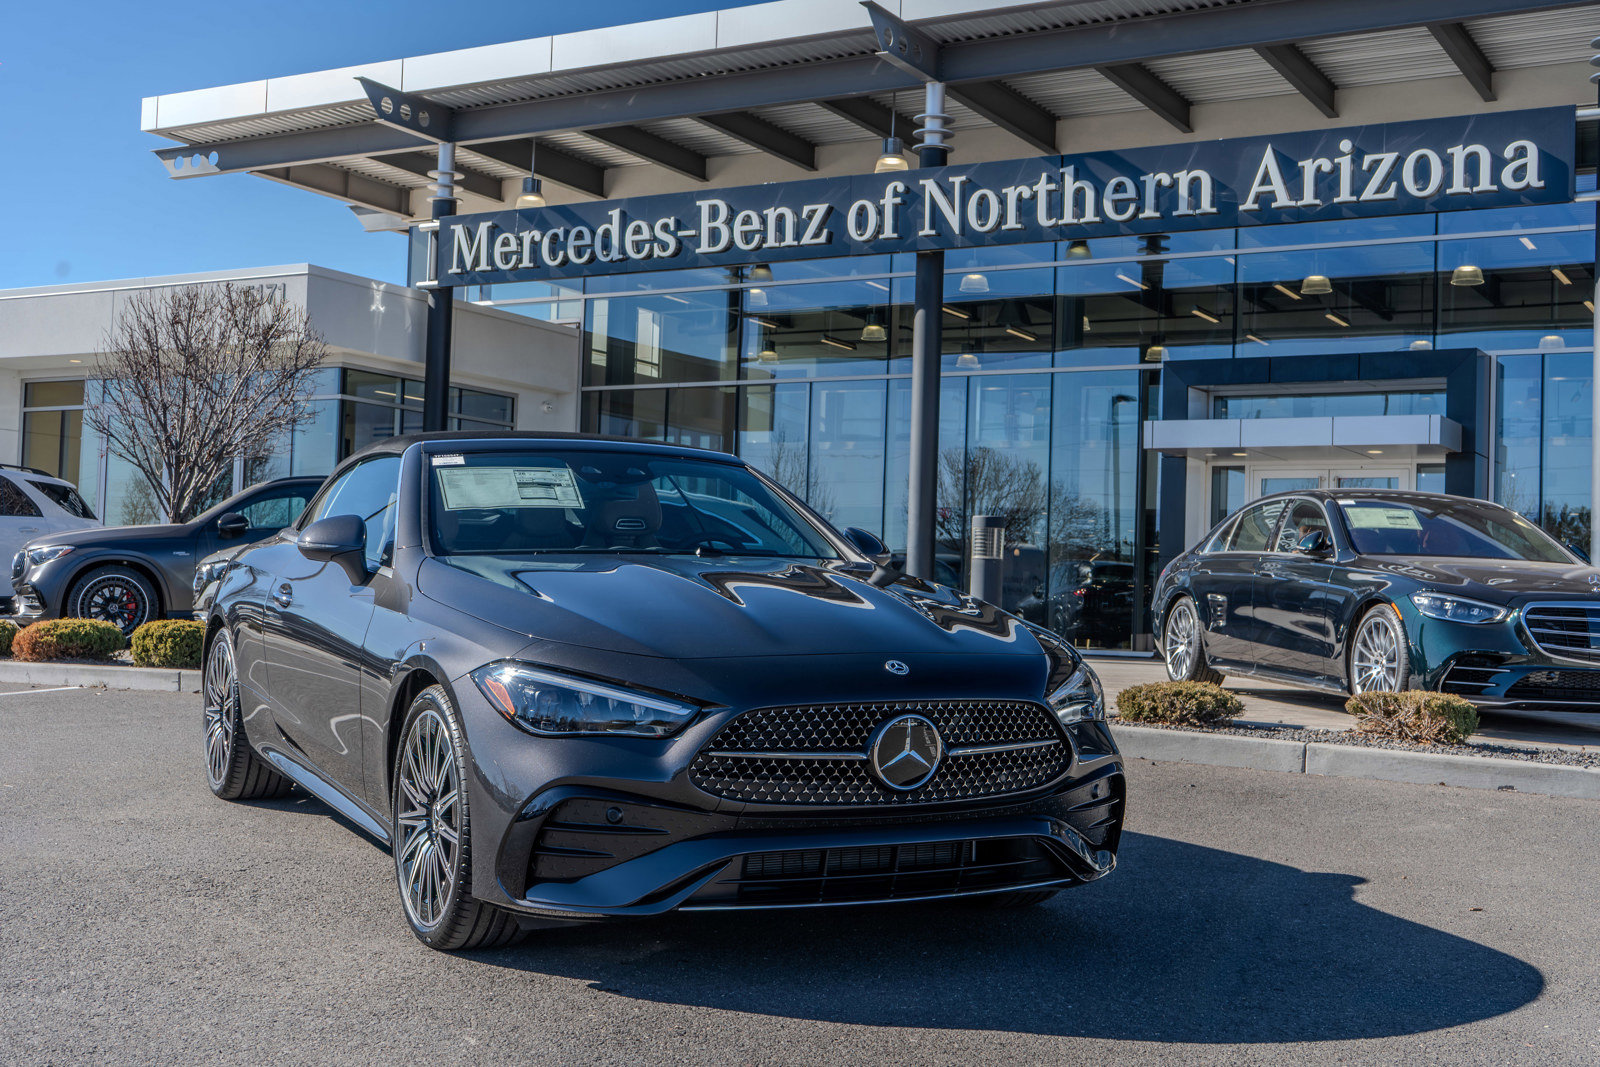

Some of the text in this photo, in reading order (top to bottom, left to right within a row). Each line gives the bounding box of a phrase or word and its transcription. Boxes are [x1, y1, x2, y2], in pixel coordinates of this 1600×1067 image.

[447, 138, 1545, 274] Mercedes-Benz of Northern Arizona
